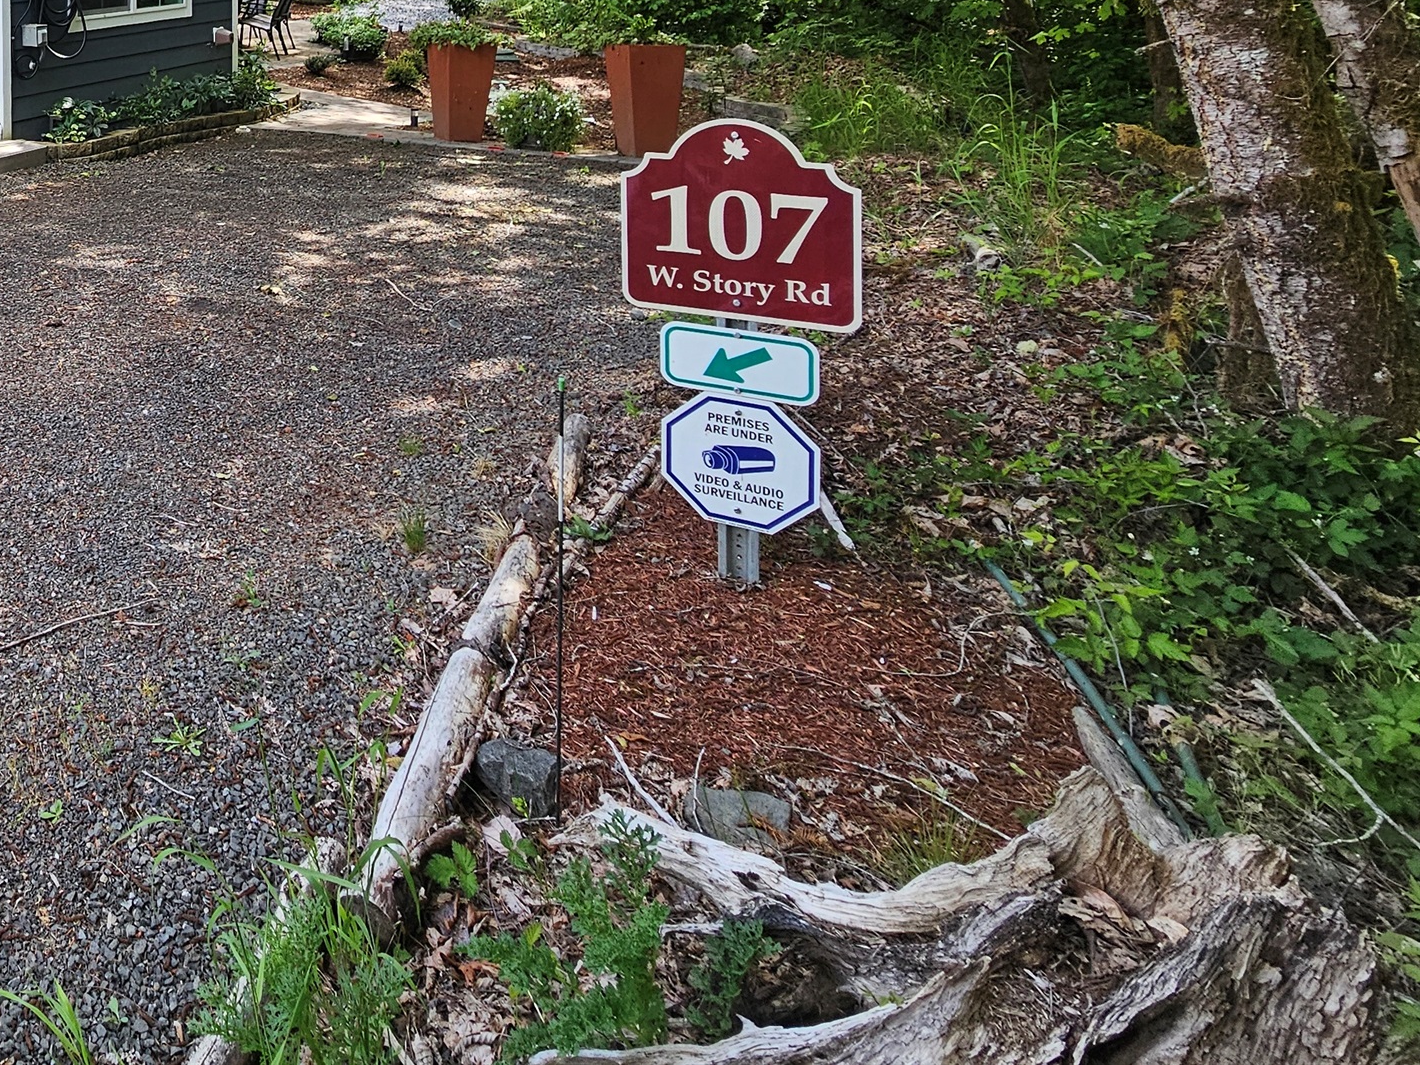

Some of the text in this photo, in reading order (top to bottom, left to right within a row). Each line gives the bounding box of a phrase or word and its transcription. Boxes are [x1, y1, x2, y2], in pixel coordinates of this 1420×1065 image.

[651, 185, 829, 264] 107
[646, 264, 832, 307] W. Story Rd
[704, 423, 774, 444] ARE UNDER
[707, 412, 770, 432] PREMISES
[694, 472, 784, 499] VIDEO & AUDIO
[694, 483, 785, 511] SURVEILLANCE
